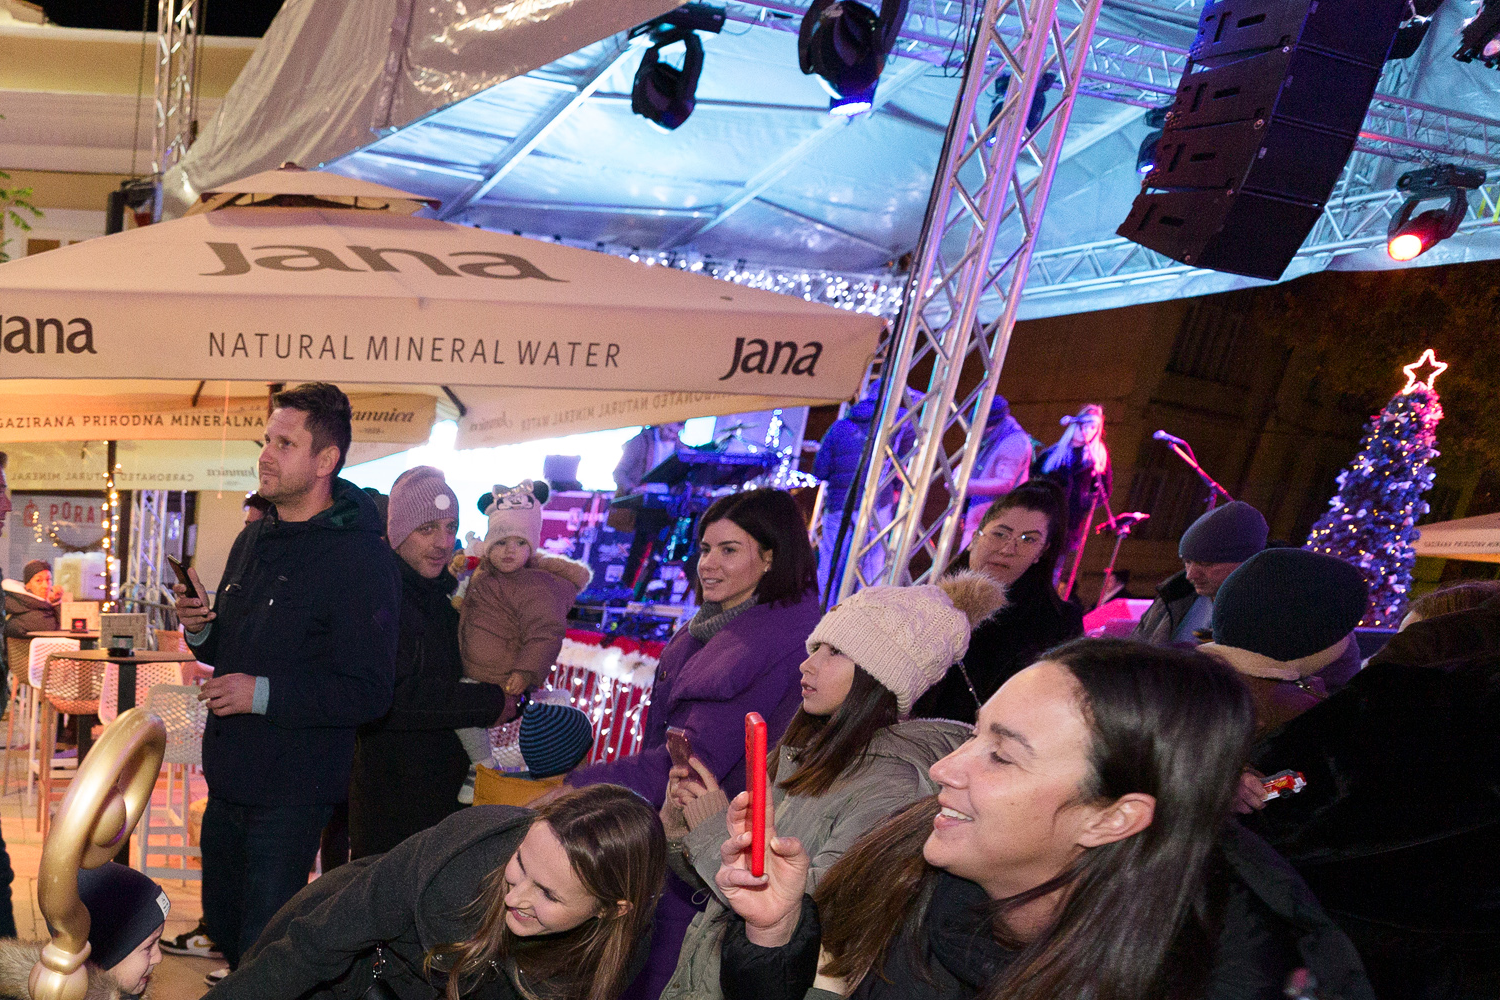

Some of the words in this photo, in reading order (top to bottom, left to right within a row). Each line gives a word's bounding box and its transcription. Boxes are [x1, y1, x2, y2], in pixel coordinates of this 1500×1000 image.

[199, 241, 571, 283] Jana
[208, 332, 355, 360] NATURAL
[366, 336, 505, 365] MINERAL
[518, 340, 620, 368] WATER
[719, 337, 824, 381] Jana
[83, 414, 164, 427] PRIRODNA
[170, 414, 265, 427] MINERALNA
[351, 407, 415, 423] amnica
